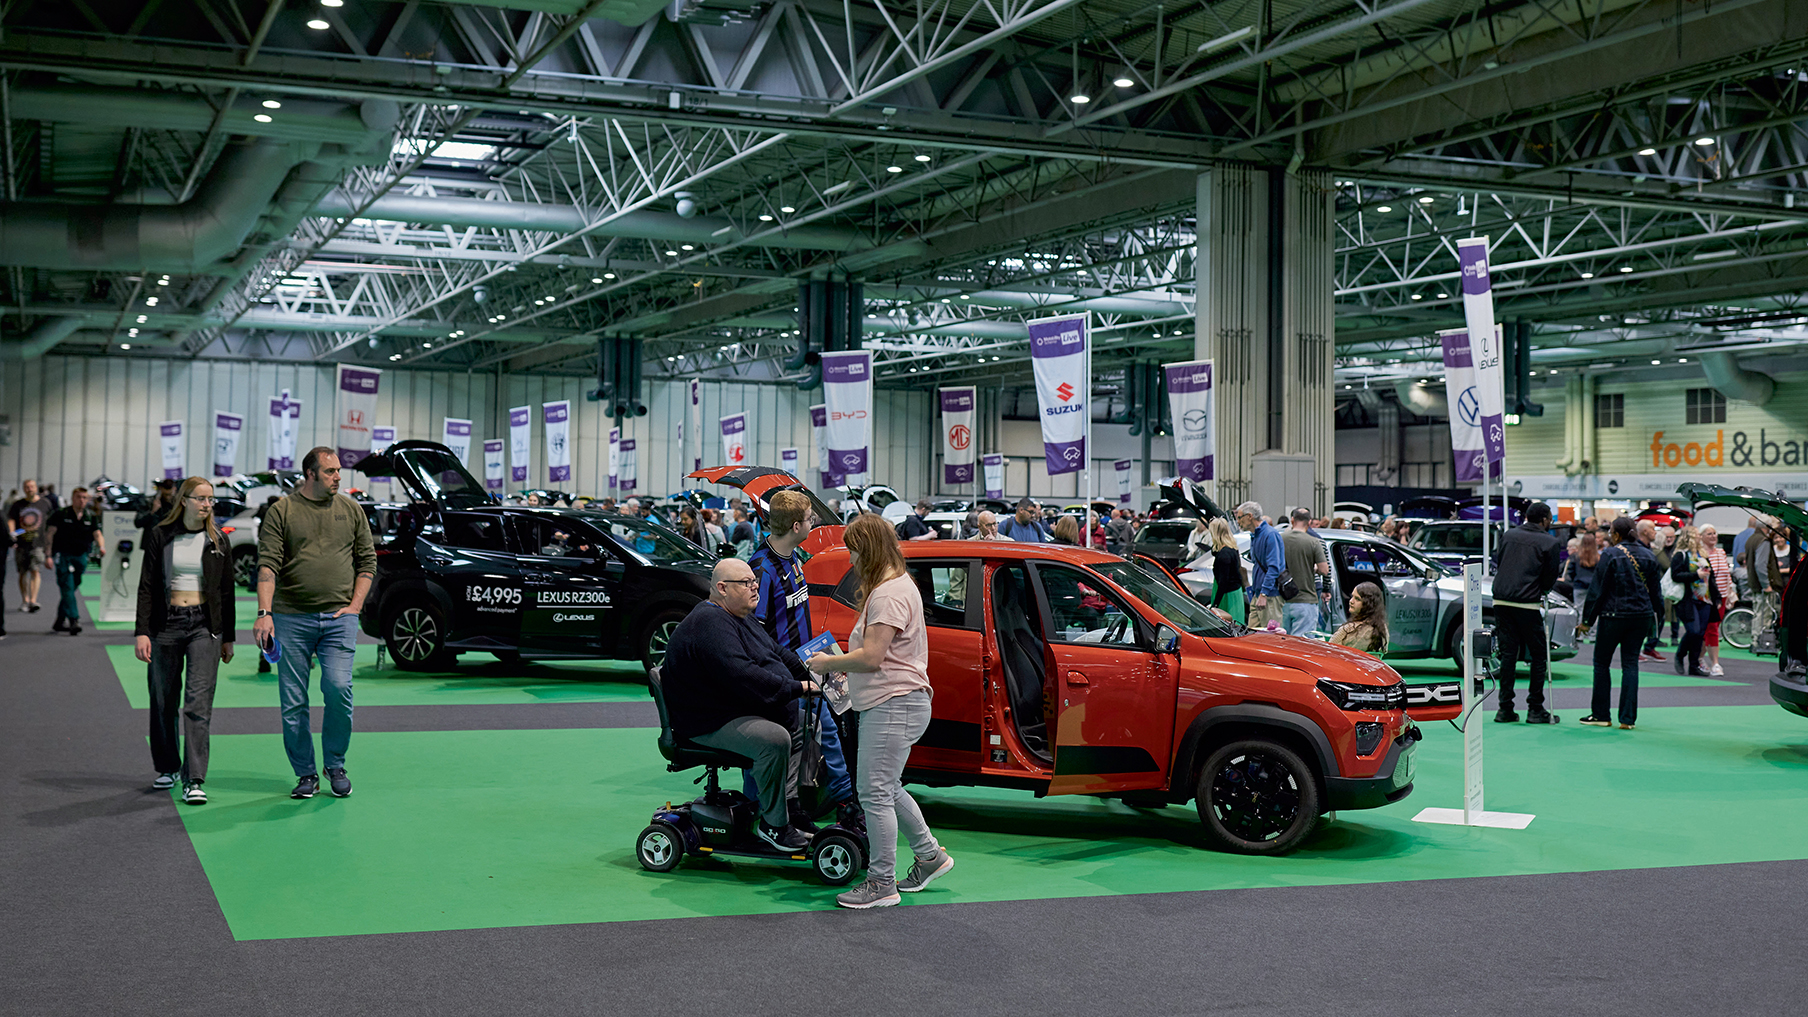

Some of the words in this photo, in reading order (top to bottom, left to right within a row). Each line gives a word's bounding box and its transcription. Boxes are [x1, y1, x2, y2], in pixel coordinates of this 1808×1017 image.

[1063, 333, 1078, 342] Live
[1046, 403, 1083, 416] SUZUK
[1650, 429, 1724, 467] food
[1731, 431, 1754, 467] &
[471, 585, 522, 605] £4,995
[537, 592, 571, 603] LEXUS
[572, 592, 611, 603] RZ300e
